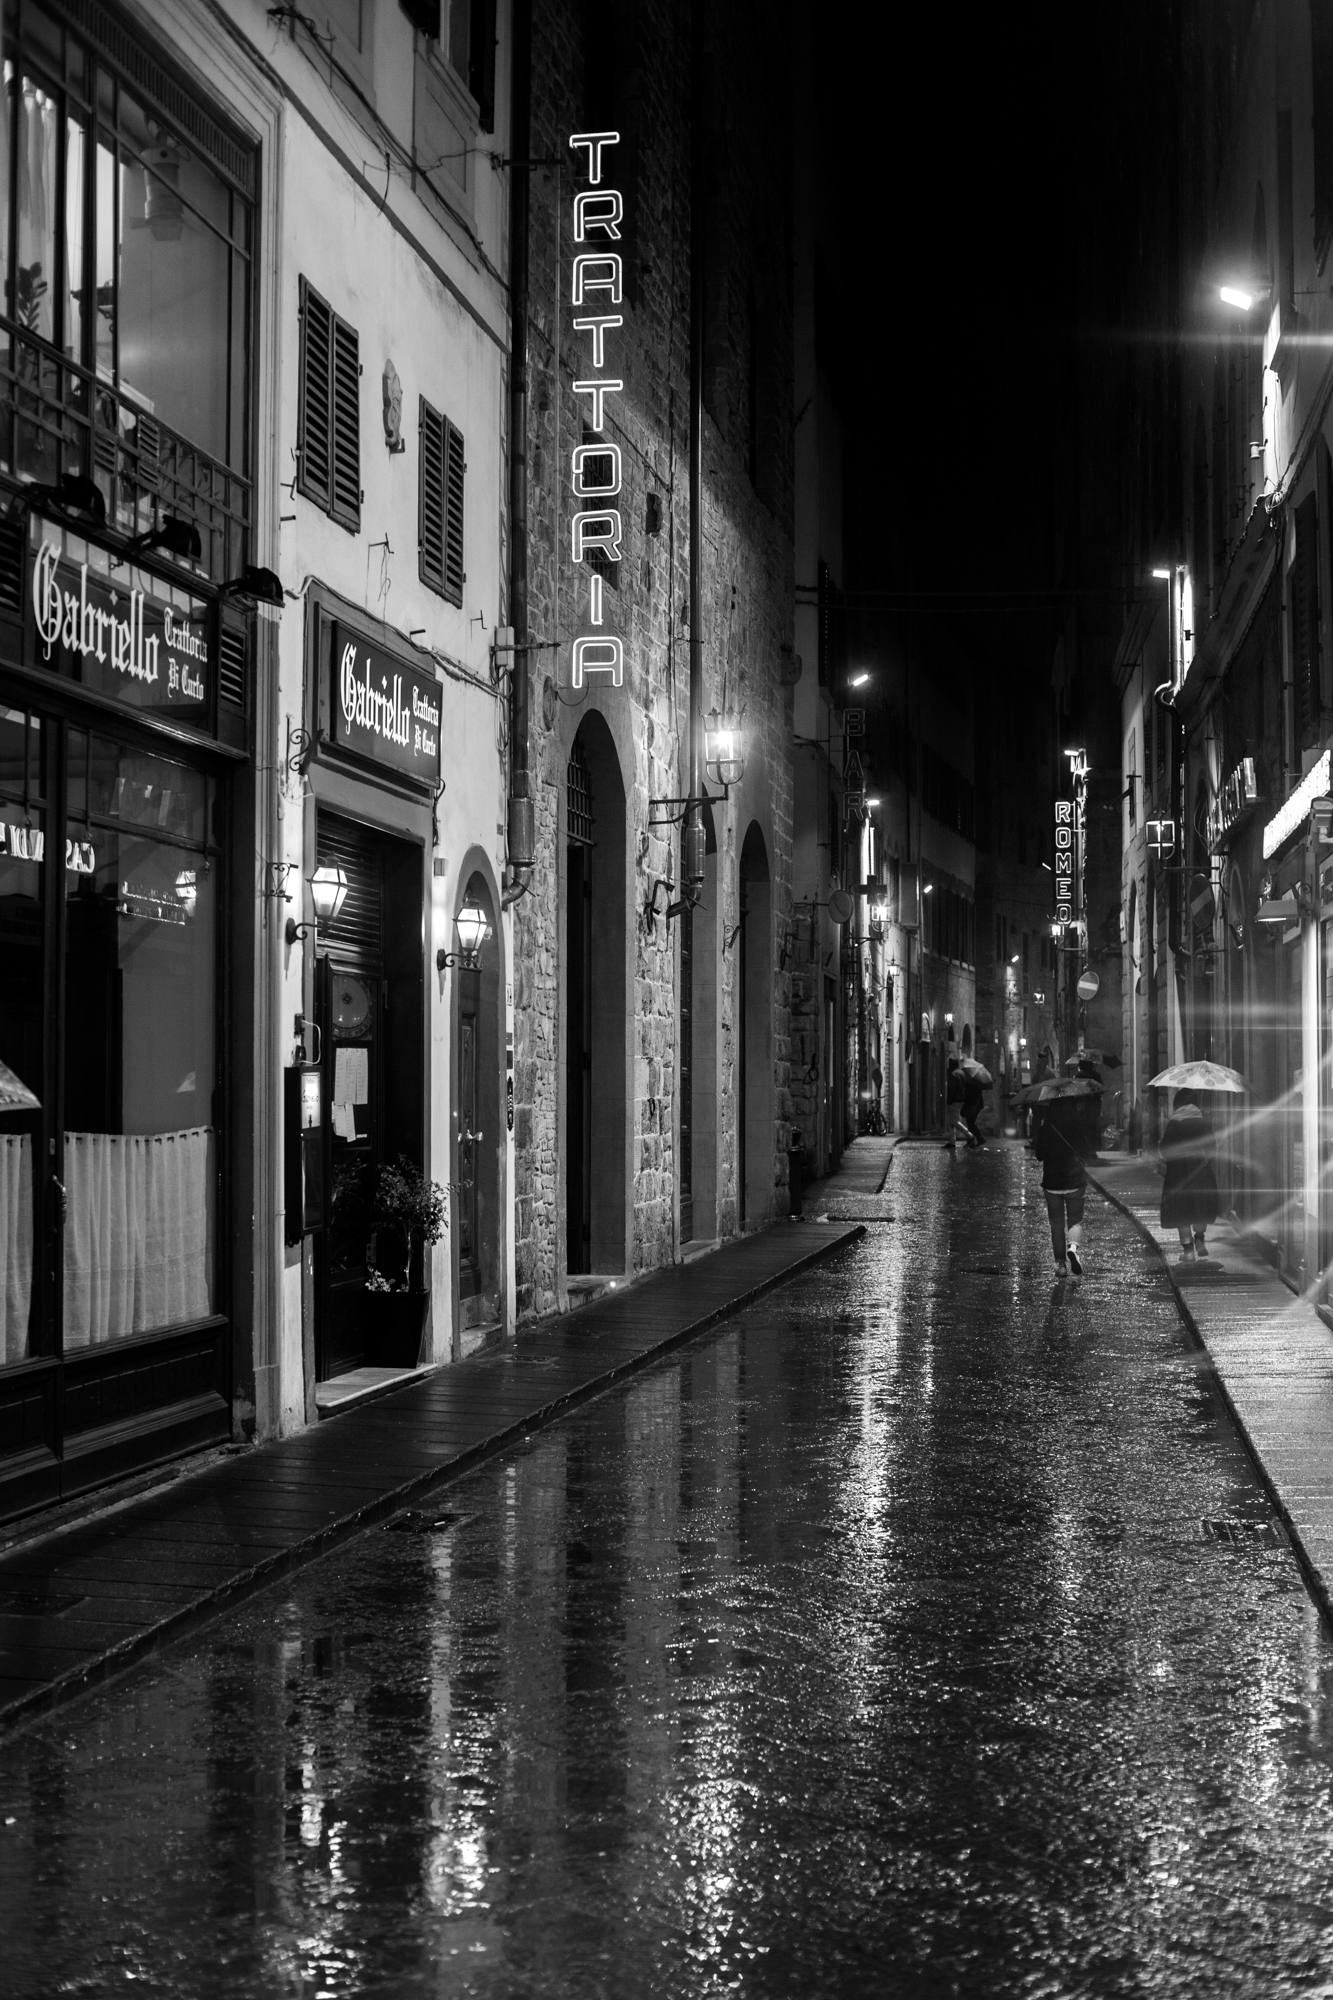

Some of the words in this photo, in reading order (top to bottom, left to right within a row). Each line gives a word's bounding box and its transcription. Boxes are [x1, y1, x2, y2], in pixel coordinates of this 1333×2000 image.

[568, 131, 625, 688] TRATTORIA
[33, 541, 160, 683] Gabriello
[163, 606, 208, 663] Trattoria
[340, 642, 410, 747] Gabriello
[413, 685, 438, 727] Trattoria
[842, 708, 867, 820] BAR
[1055, 801, 1072, 925] ROMEO
